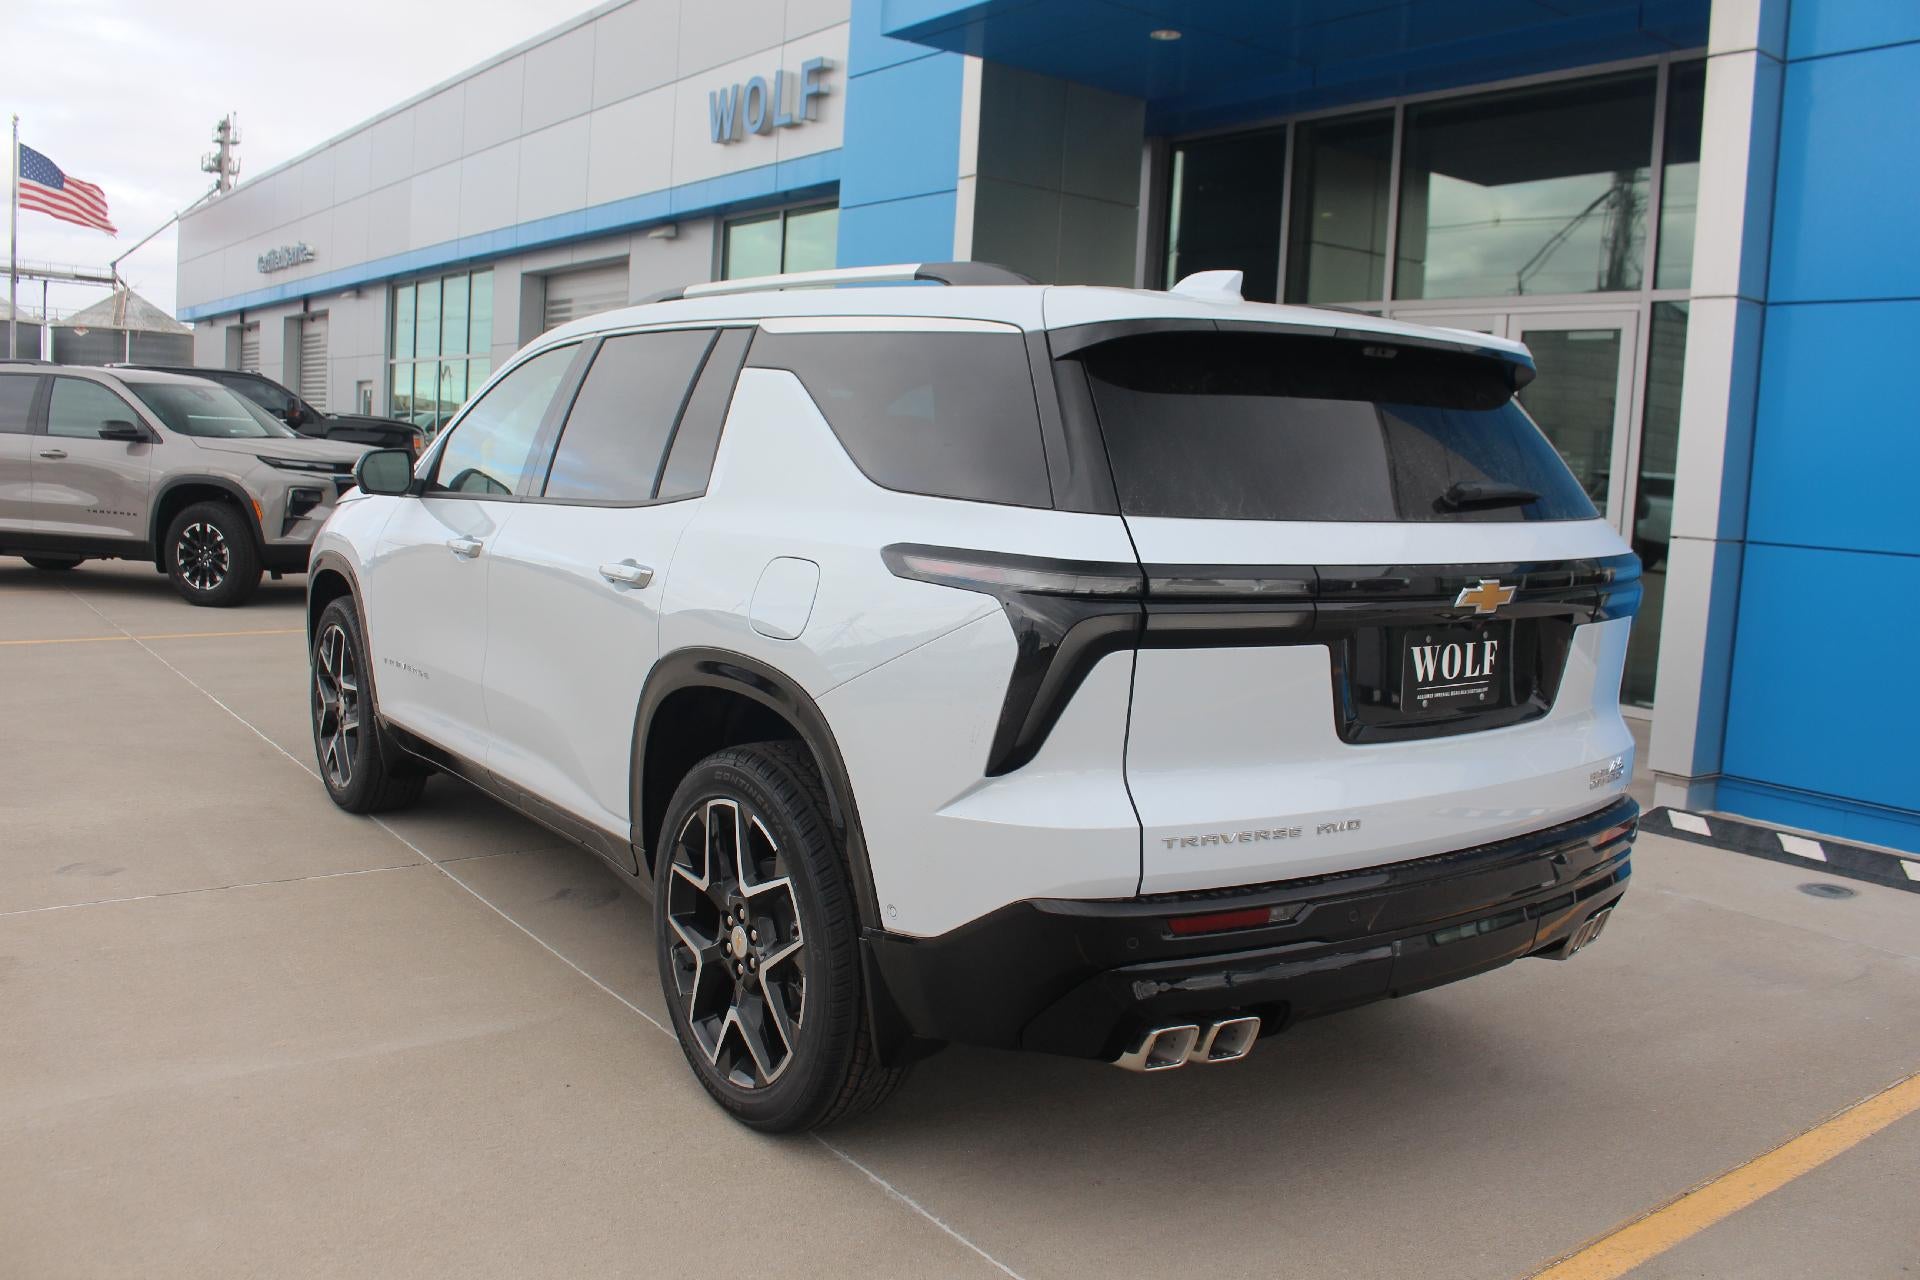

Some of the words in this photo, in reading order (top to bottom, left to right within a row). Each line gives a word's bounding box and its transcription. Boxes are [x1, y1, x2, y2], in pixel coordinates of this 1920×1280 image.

[708, 56, 832, 144] WOLF
[1411, 640, 1498, 683] WOLF
[1161, 825, 1303, 849] TRAVERSE
